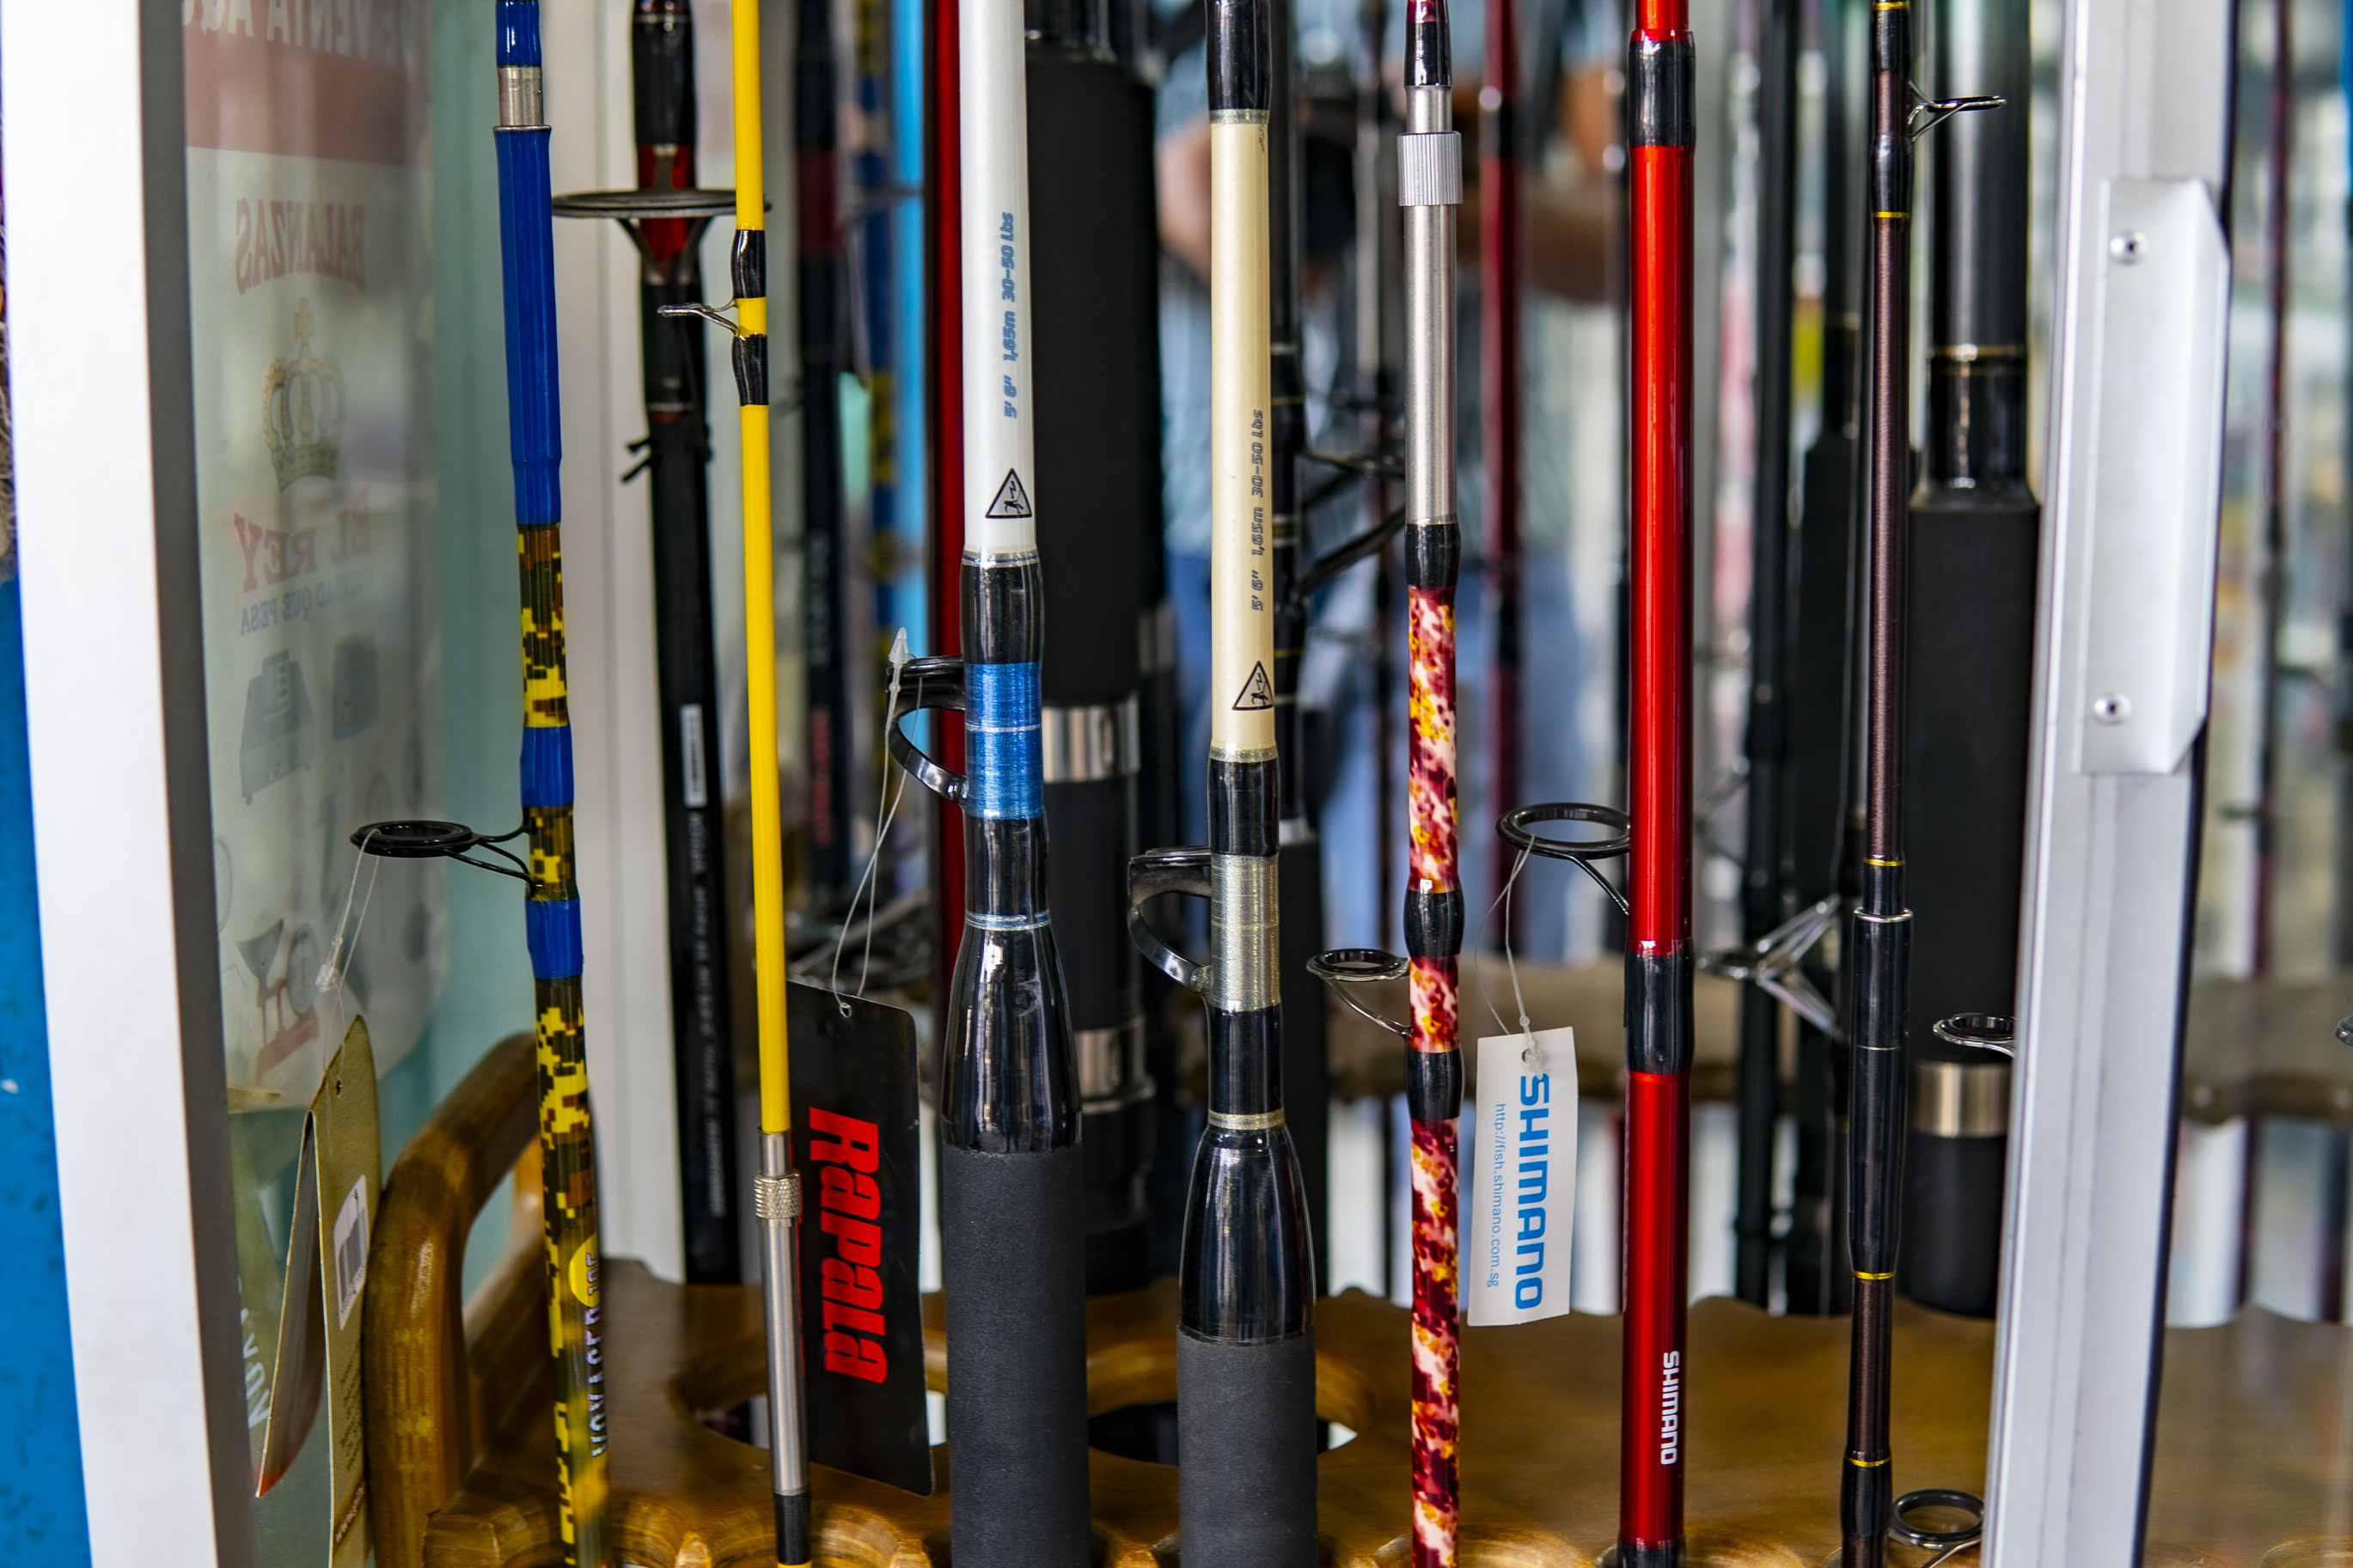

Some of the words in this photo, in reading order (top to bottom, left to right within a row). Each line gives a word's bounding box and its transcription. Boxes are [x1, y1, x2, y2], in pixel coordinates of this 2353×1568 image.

[999, 212, 1014, 241] Lbs
[1000, 245, 1015, 302] 30-50
[1003, 311, 1018, 362] 1,65m
[1251, 410, 1263, 438] Lbs
[1251, 442, 1263, 498] 30-50
[1251, 507, 1265, 557] 1,65m
[1486, 1103, 1507, 1288] http://fish.shimano.com.sg
[1515, 1073, 1549, 1310] SHIMANO
[1660, 1351, 1680, 1465] SHIMANO
